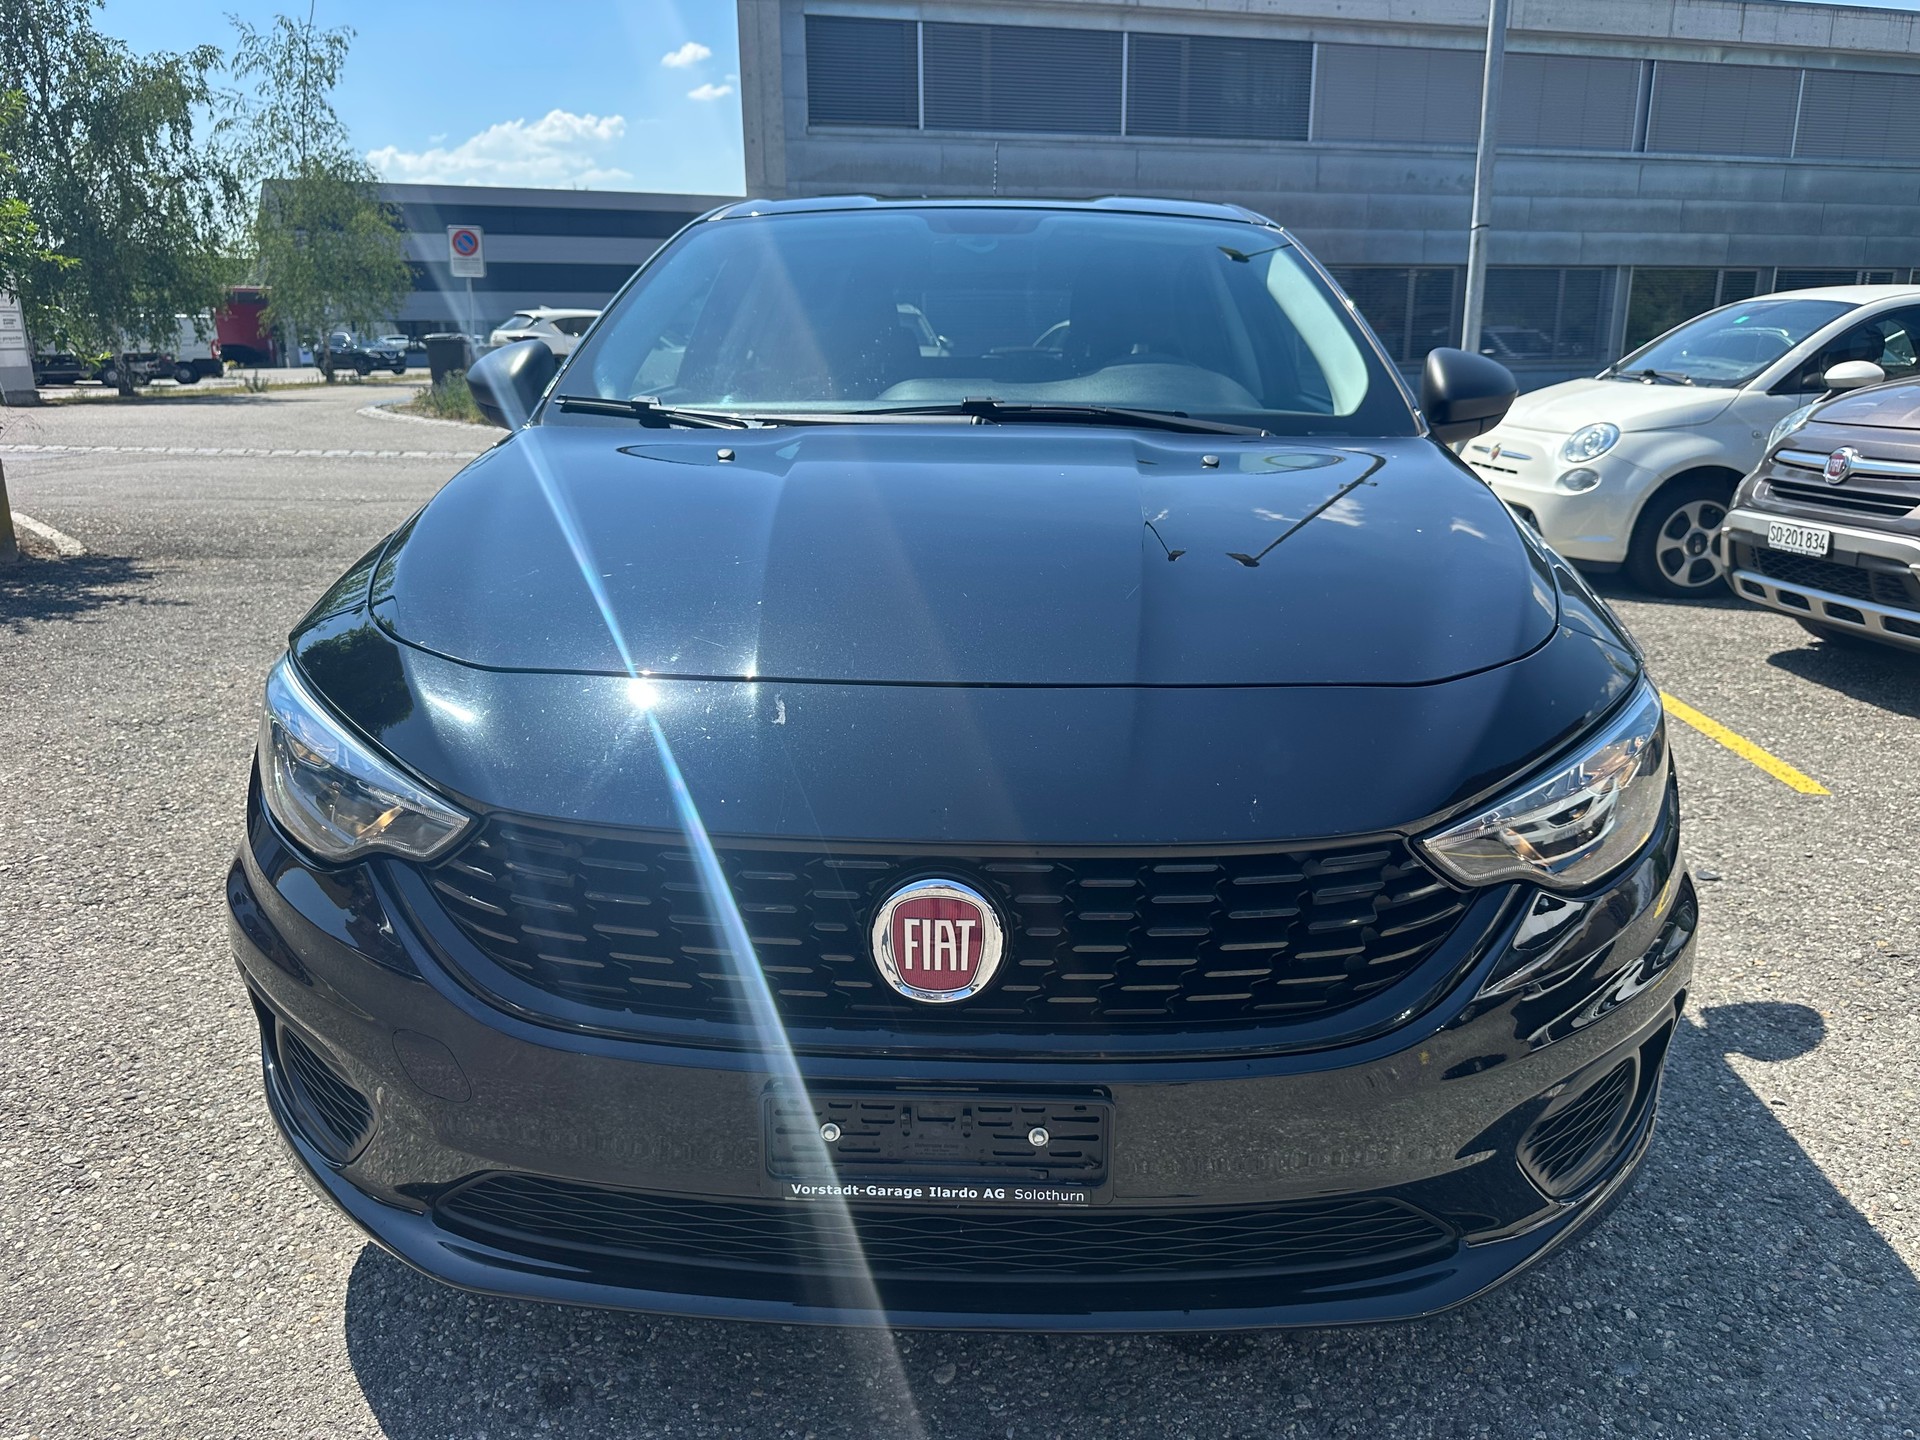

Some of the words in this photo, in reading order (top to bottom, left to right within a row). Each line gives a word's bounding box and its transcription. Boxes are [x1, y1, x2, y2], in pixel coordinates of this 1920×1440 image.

[904, 918, 976, 971] FIAT
[791, 1183, 923, 1199] Vorstadt-Garage
[929, 1186, 978, 1199] Ilardo
[983, 1188, 1005, 1199] AG
[1014, 1189, 1085, 1202] Solothurn
